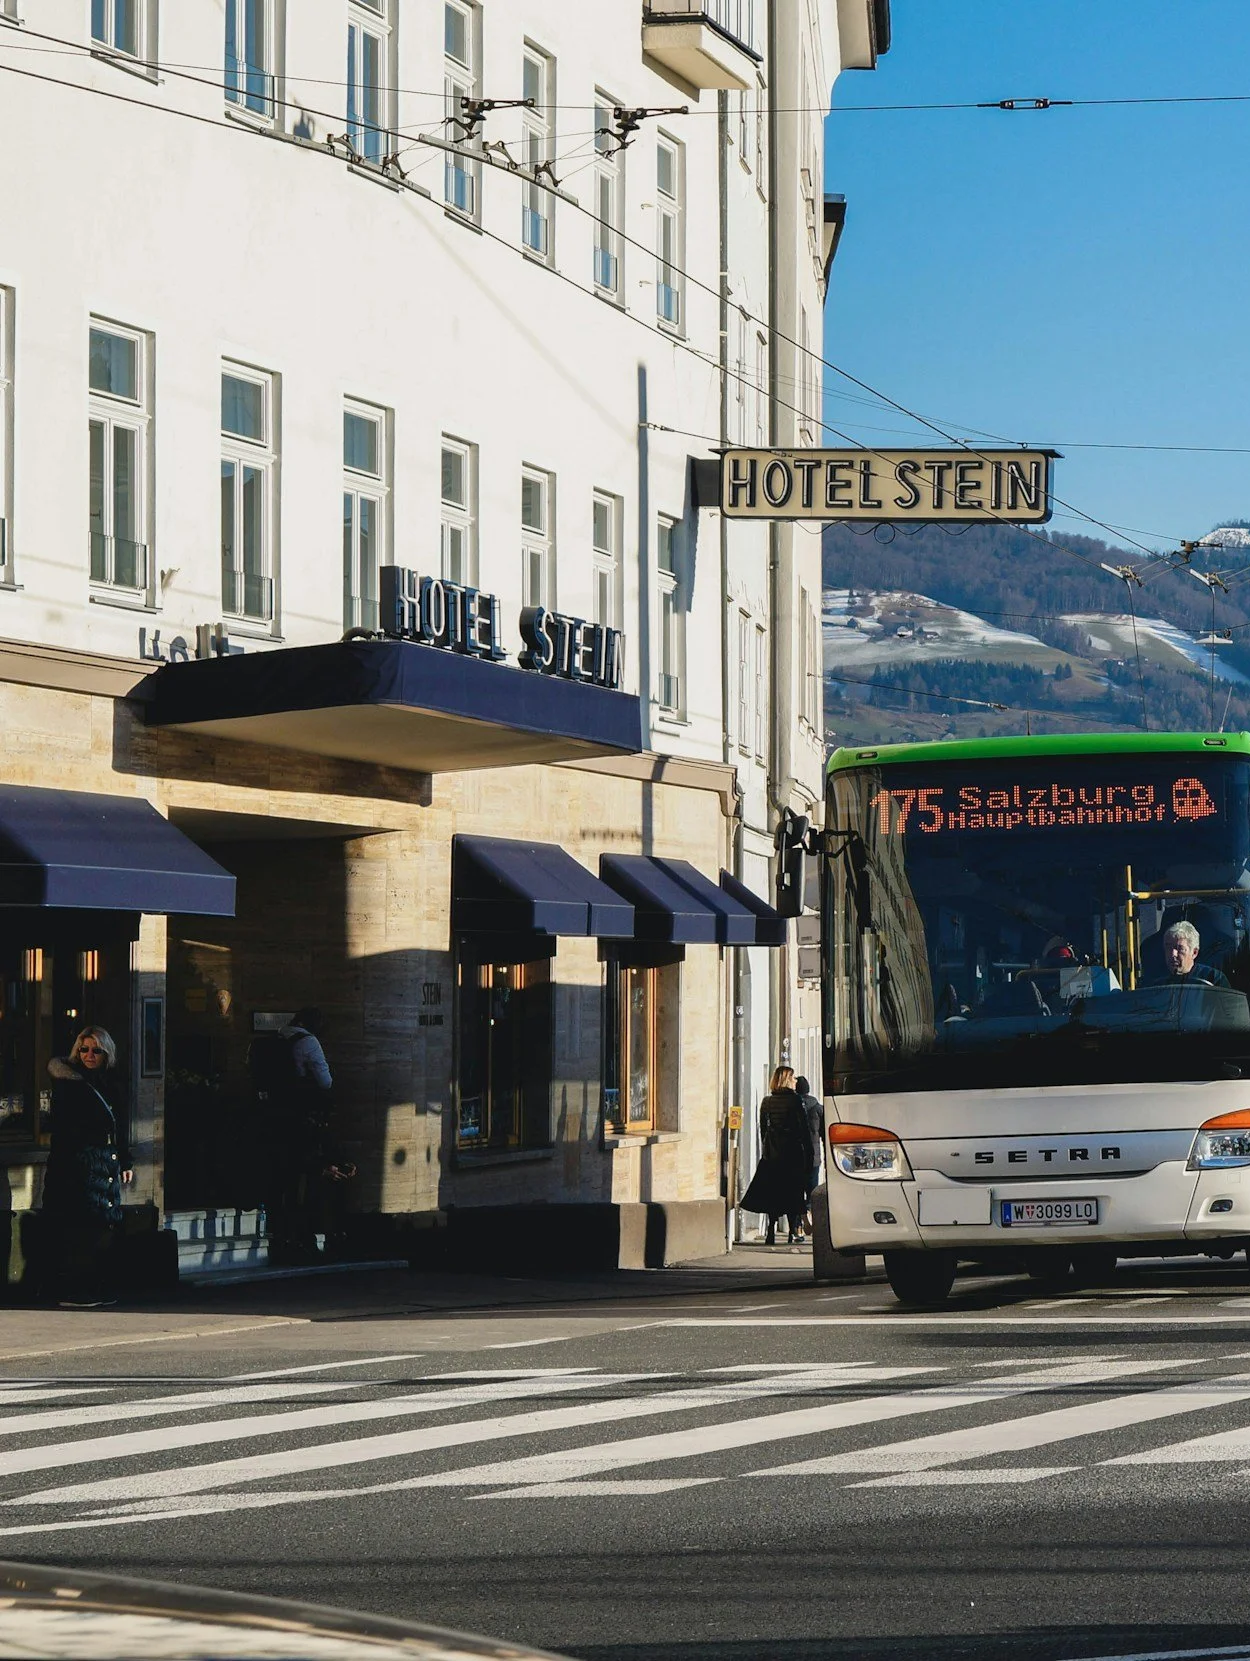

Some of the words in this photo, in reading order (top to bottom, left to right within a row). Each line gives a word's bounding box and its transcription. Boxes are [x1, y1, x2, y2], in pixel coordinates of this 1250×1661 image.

[728, 458, 882, 510] HOTEL
[893, 459, 1041, 511] STEIN
[380, 565, 512, 660] HOTEL
[517, 605, 626, 689] STEIN
[869, 788, 944, 835] 175
[958, 783, 1155, 810] Salzburg
[948, 803, 1166, 830] Hauptbahnhof
[974, 1147, 1121, 1164] SETRA
[1014, 1205, 1025, 1219] W
[1036, 1203, 1073, 1219] 3099
